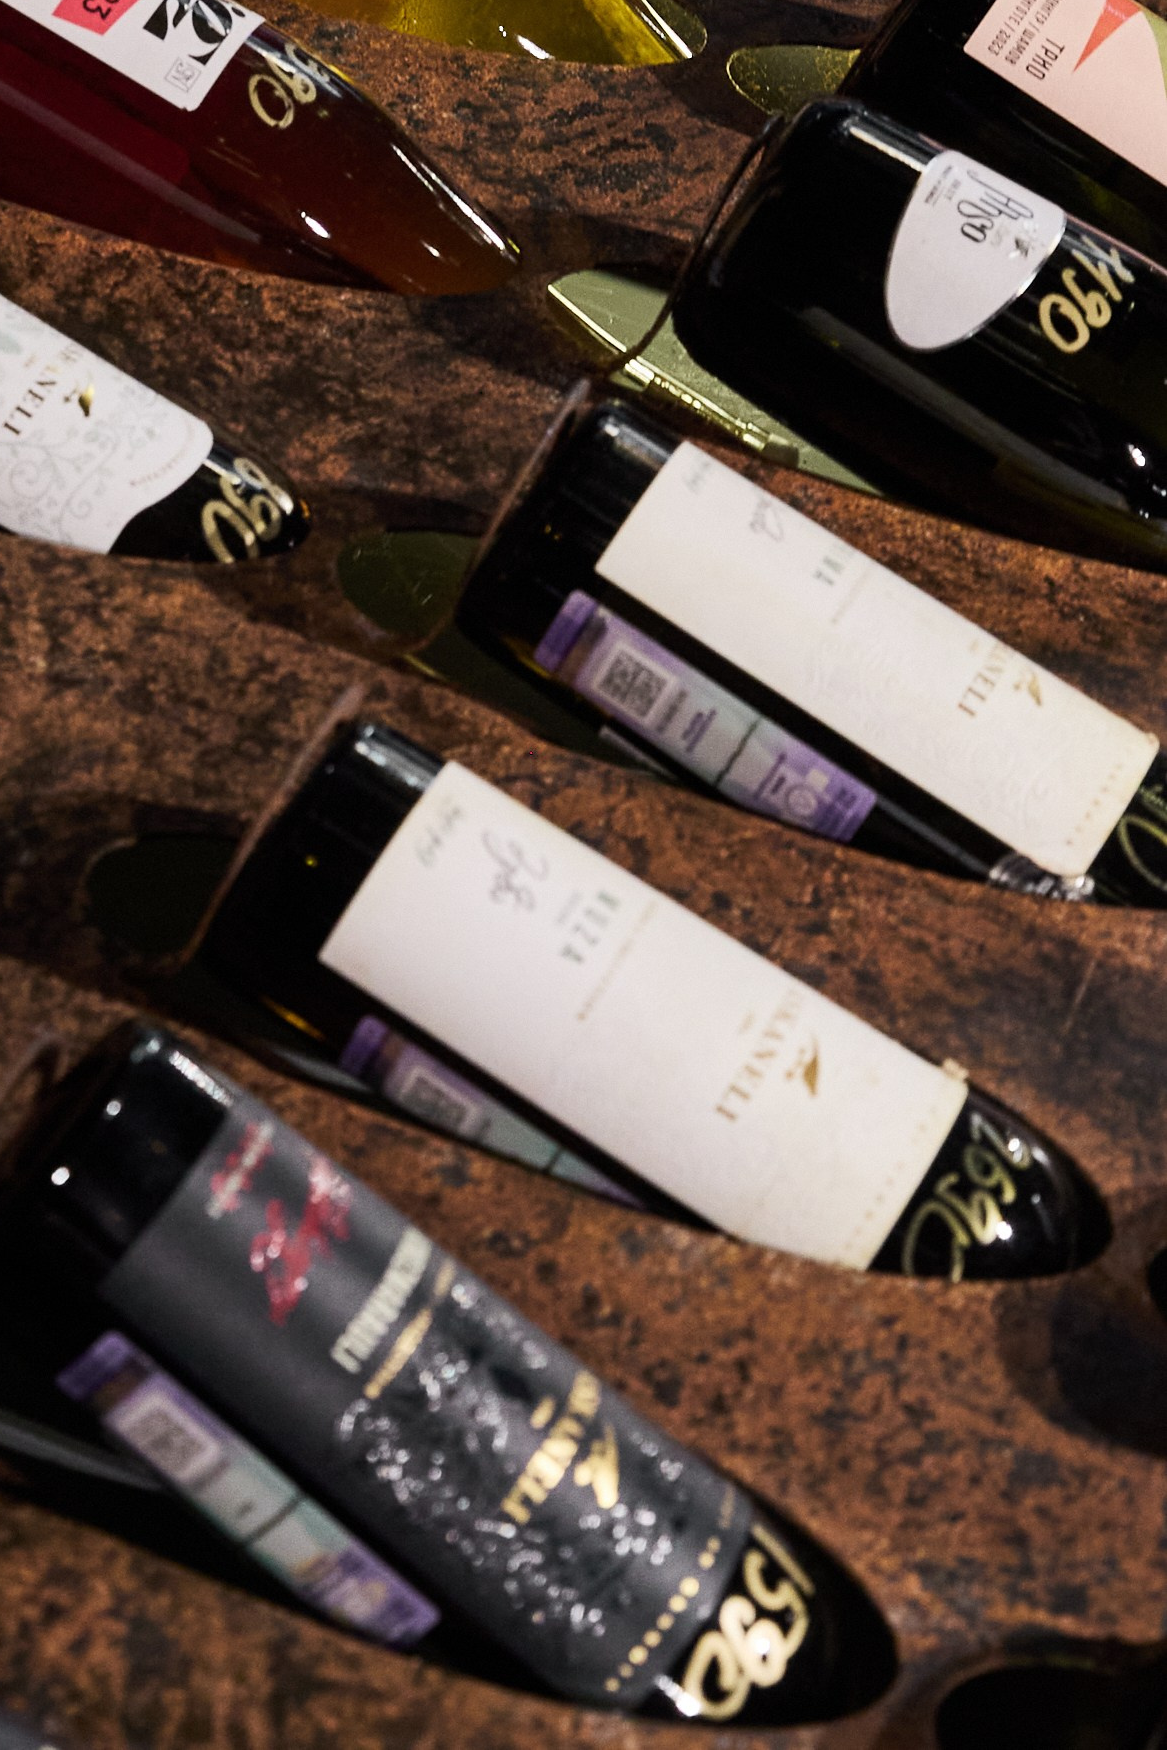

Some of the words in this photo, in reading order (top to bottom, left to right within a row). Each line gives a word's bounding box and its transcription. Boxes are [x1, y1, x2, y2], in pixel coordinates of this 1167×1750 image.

[986, 28, 1011, 56] 2023
[1024, 37, 1065, 81] ТРИО
[1040, 234, 1136, 356] 1190
